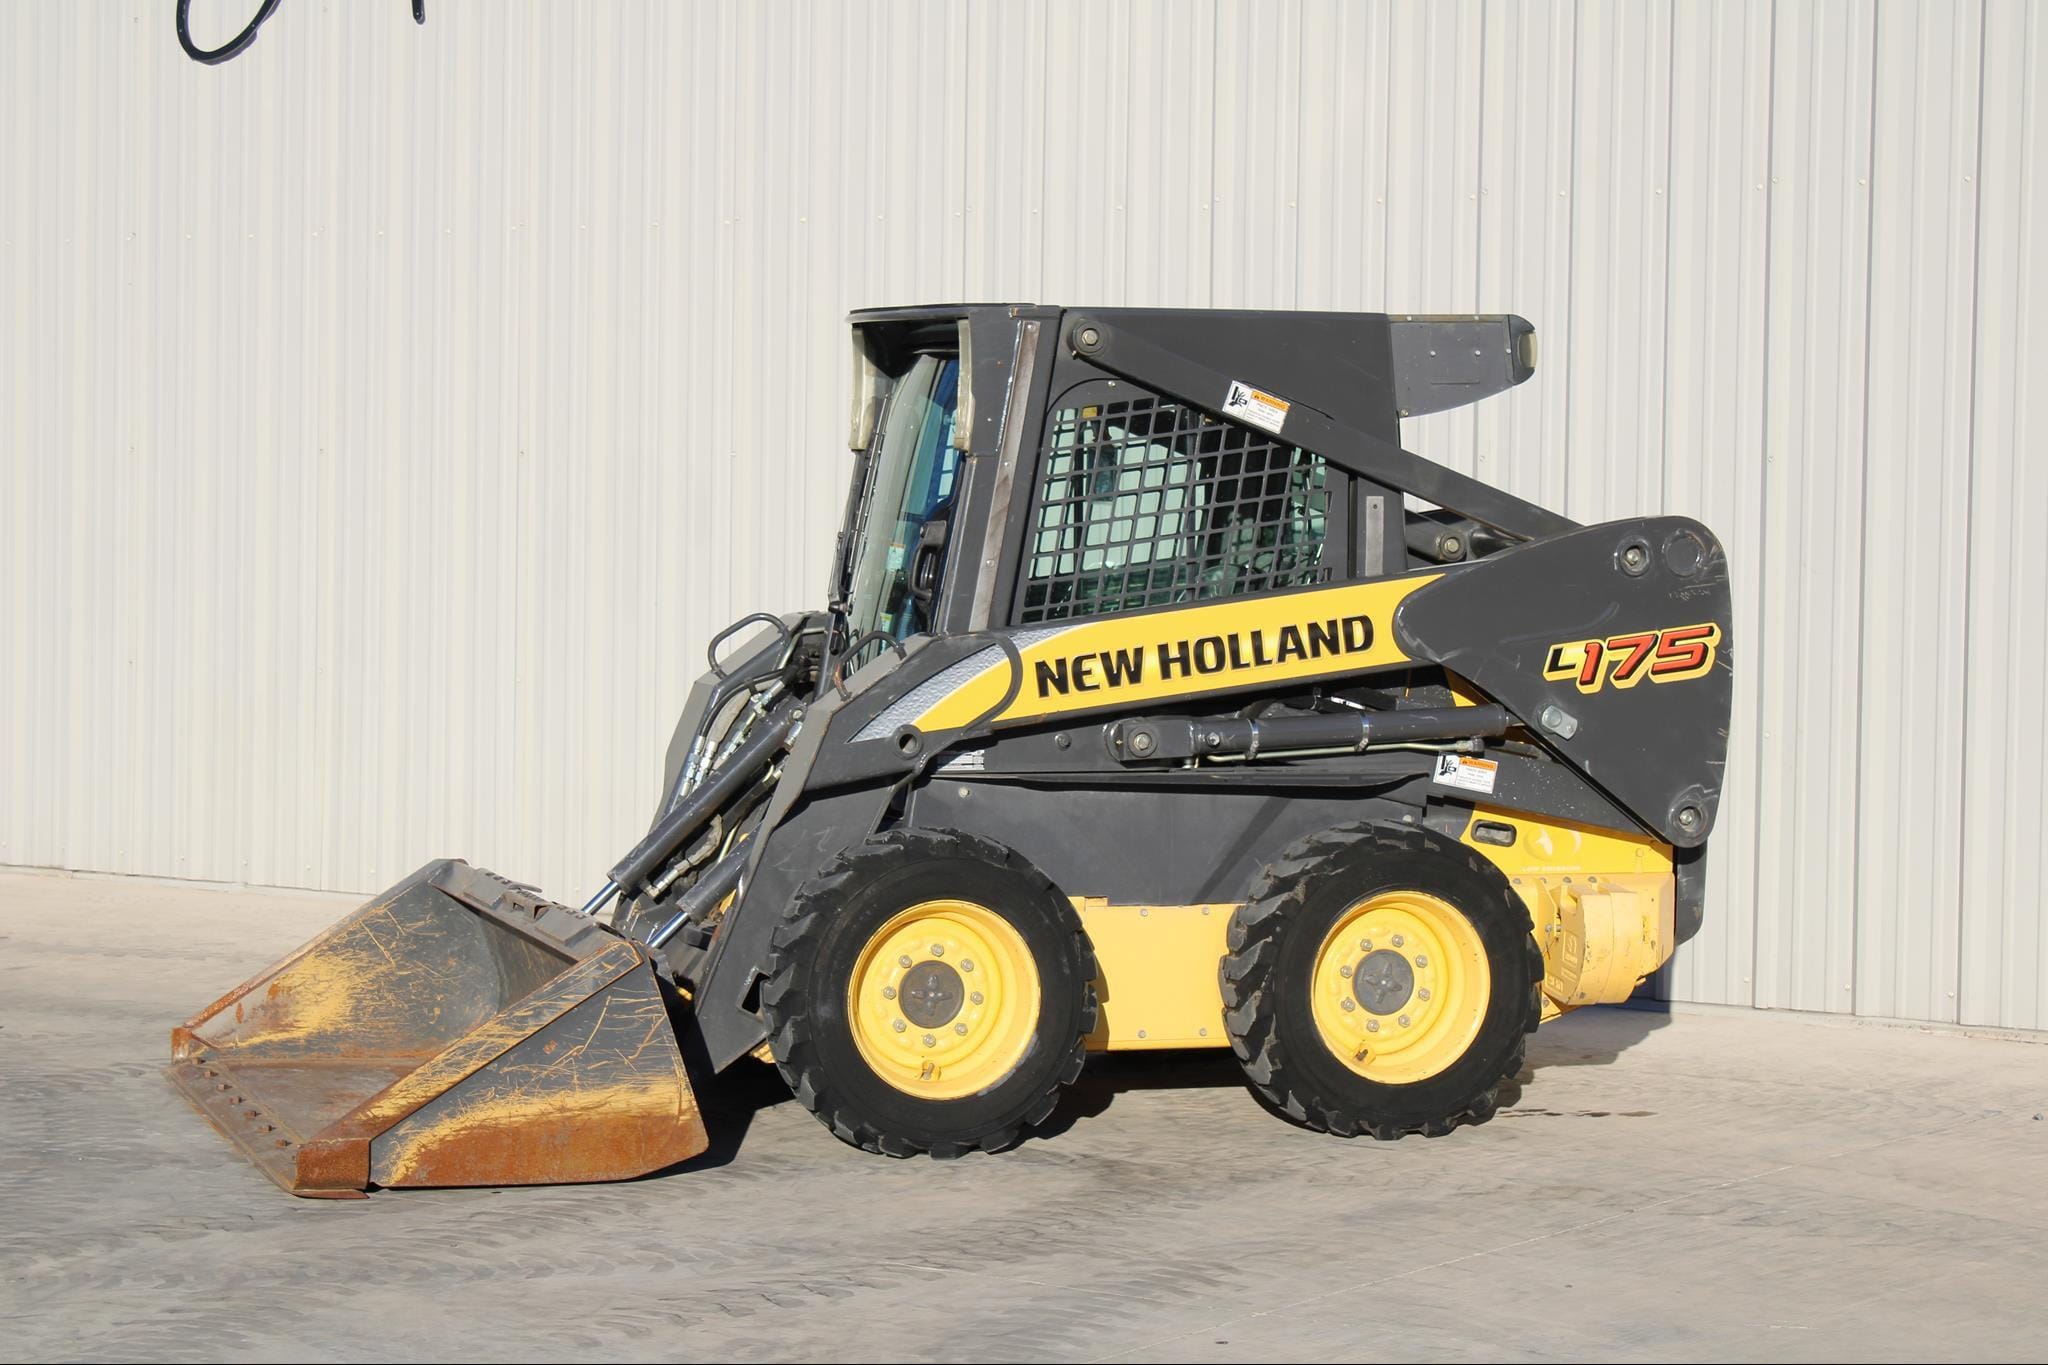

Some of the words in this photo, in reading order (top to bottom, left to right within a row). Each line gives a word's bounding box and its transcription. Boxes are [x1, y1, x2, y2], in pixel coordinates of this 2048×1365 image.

[1034, 646, 1145, 699] NEW
[1158, 614, 1375, 681] HOLLAND
[1545, 624, 1716, 688] L175
